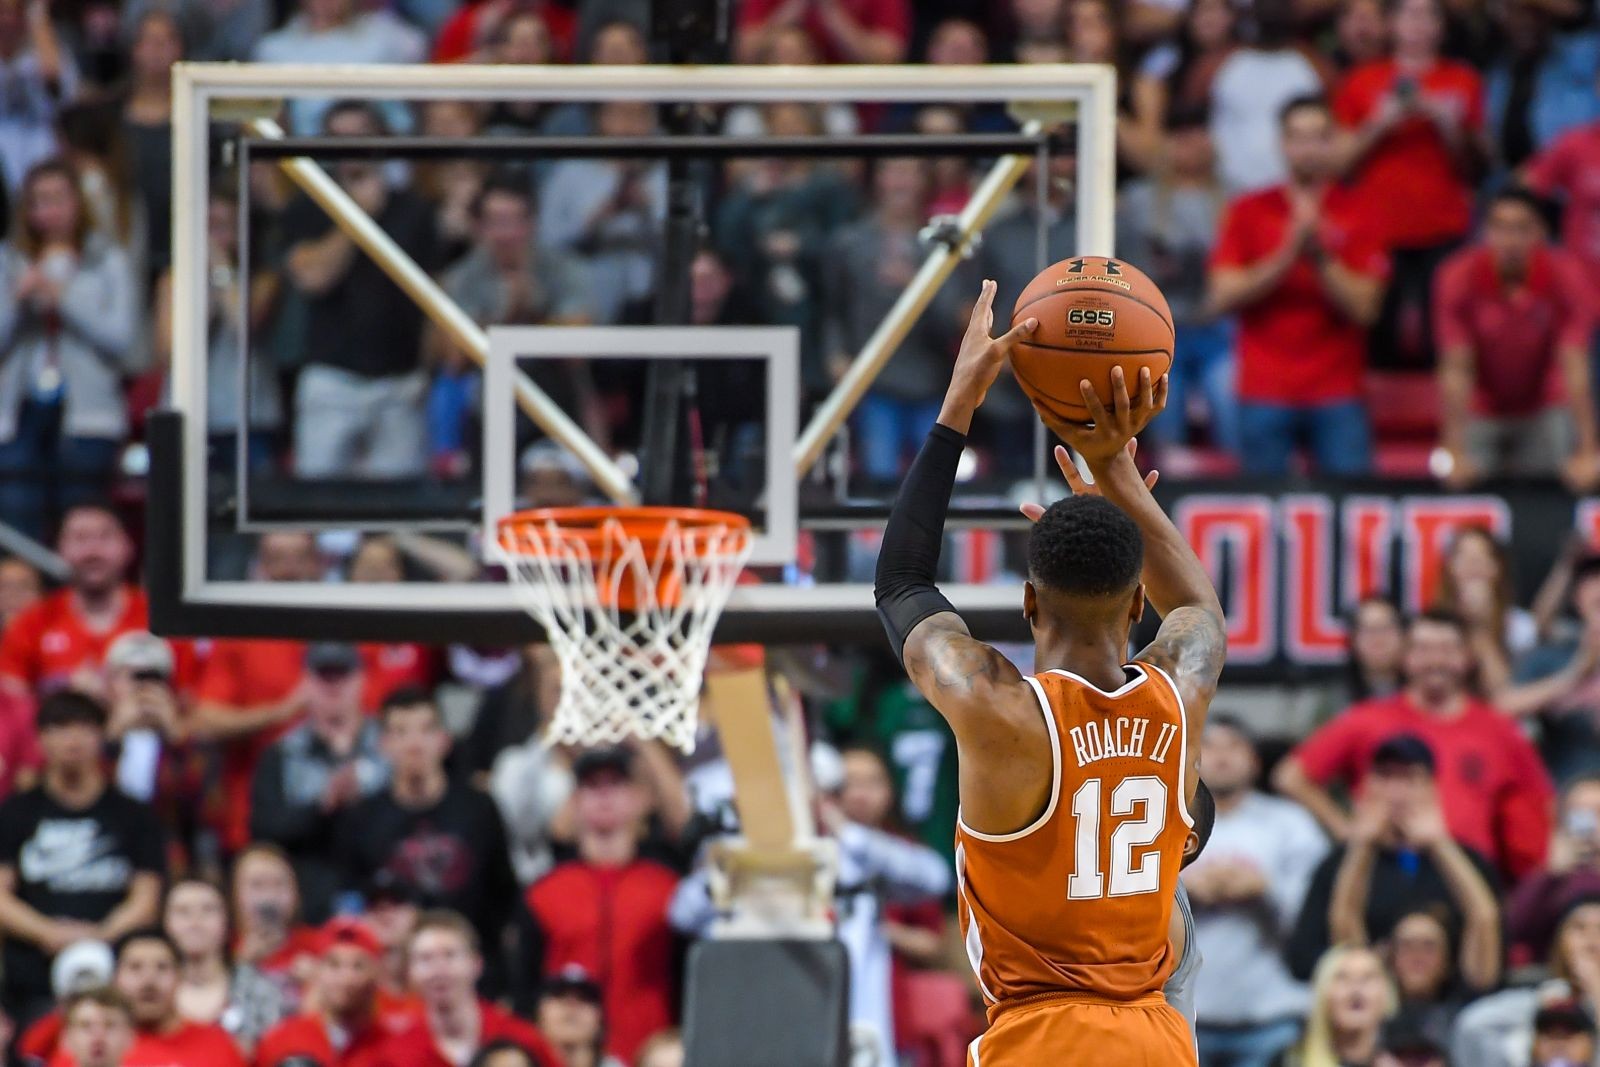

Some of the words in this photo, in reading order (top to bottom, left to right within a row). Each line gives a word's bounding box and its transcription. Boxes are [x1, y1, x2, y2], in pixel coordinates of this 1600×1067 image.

[1068, 308, 1114, 327] 695
[1069, 717, 1149, 767] ROACH
[1149, 722, 1178, 763] II
[1067, 775, 1168, 900] 12
